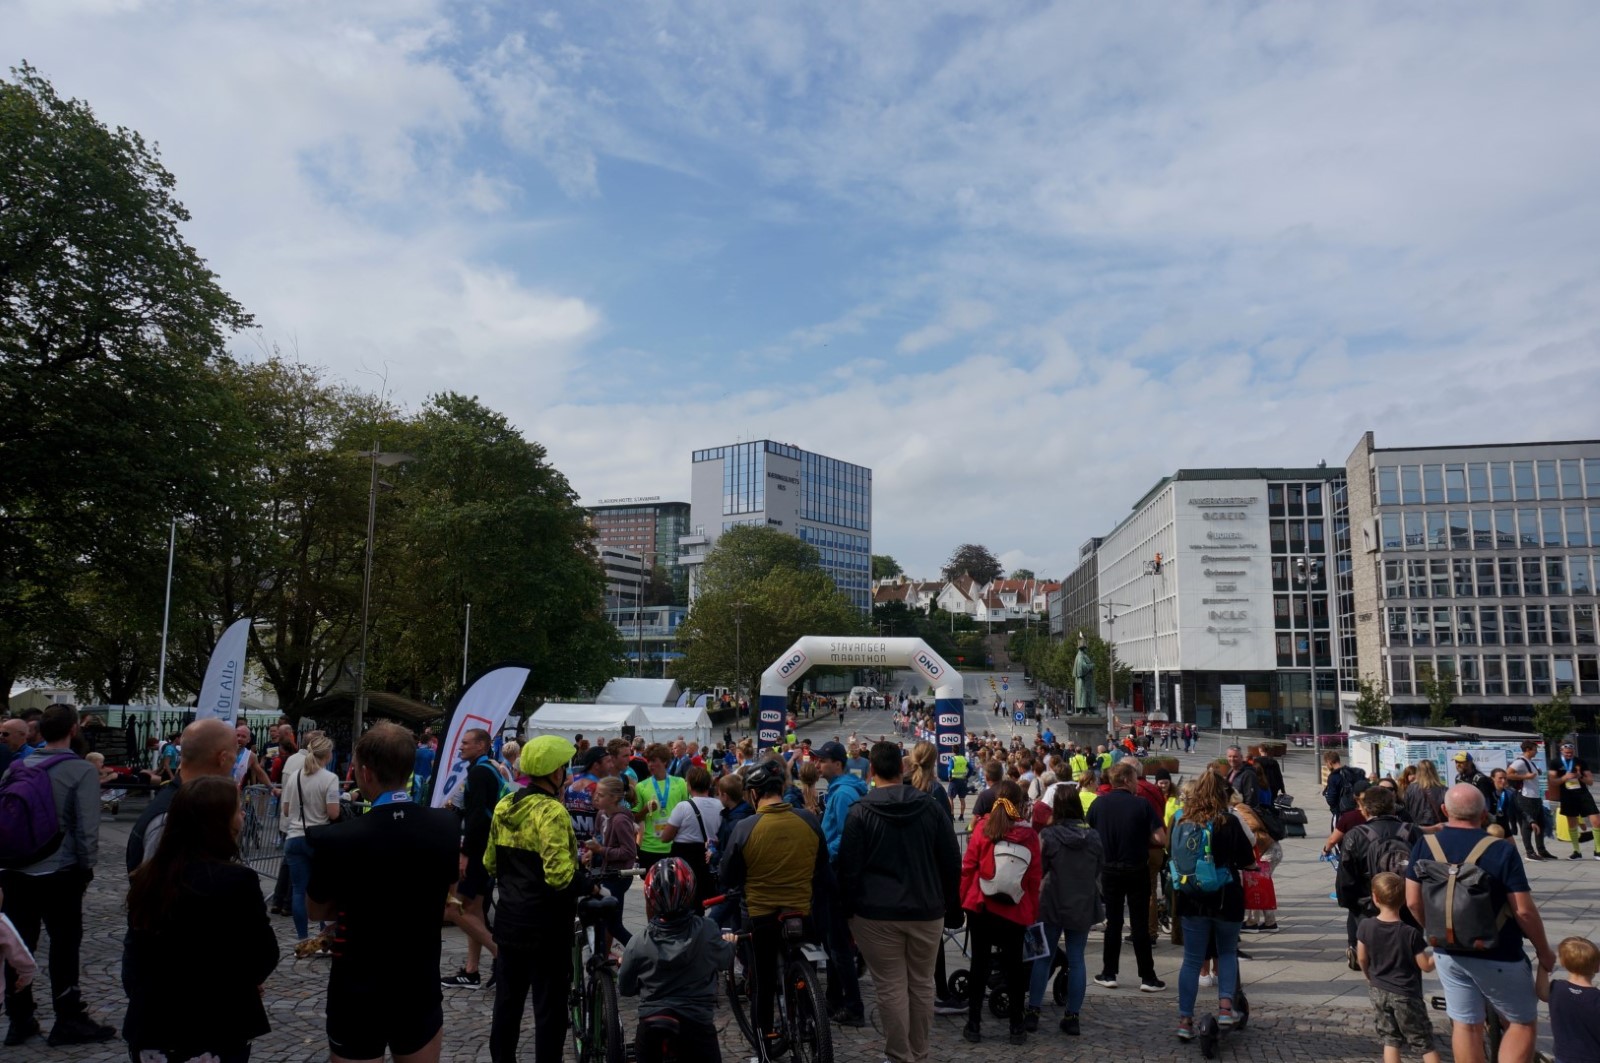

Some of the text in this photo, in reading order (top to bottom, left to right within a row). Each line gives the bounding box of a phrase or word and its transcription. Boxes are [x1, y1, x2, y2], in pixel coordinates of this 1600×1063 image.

[831, 642, 886, 652] STAVANGER
[831, 653, 887, 663] MARATHON
[781, 655, 801, 674] DNO
[918, 655, 939, 674] DNO
[762, 712, 779, 720] DNO
[761, 731, 778, 739] DNO
